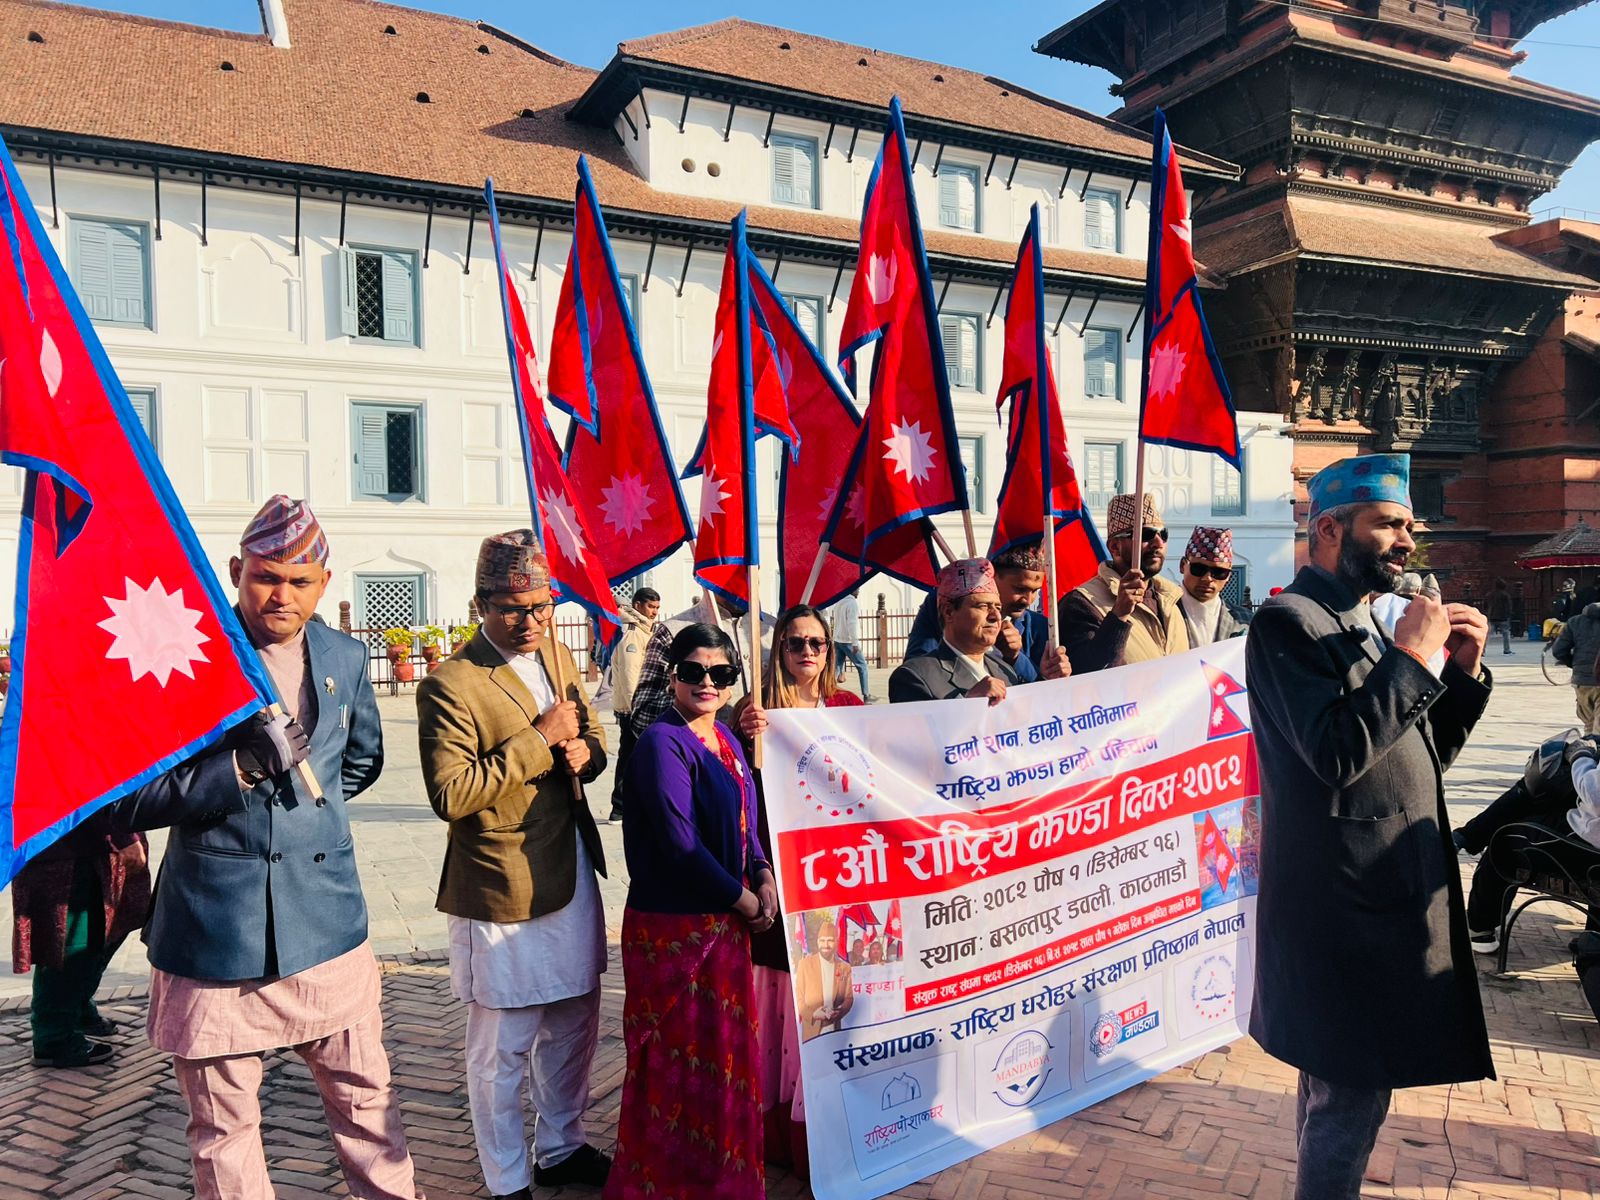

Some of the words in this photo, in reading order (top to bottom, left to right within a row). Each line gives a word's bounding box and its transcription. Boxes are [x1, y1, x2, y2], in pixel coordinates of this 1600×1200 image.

[944, 736, 980, 765] हाम्रो
[1028, 716, 1063, 744] हाम्रो
[1068, 701, 1140, 734] स्वाभिमान
[936, 775, 1000, 802] राष्ट्रिय
[1059, 746, 1095, 776] हाम्रो
[902, 819, 1019, 880] राष्ट्रिय
[983, 881, 1028, 912] २०८२
[1033, 866, 1065, 893] पौष
[1069, 864, 1080, 881] १
[1086, 838, 1149, 878] (डिसेम्बर
[1153, 830, 1181, 853] १६)
[989, 903, 1063, 948] बसन्तपुर
[951, 1003, 1016, 1041] राष्ट्रिय
[1021, 980, 1077, 1015] धरोहर
[1082, 955, 1137, 993] संरक्षण
[1142, 929, 1200, 971] प्रतिष्ठान
[1203, 912, 1246, 941] नेपाल
[1124, 1004, 1145, 1023] NEWS
